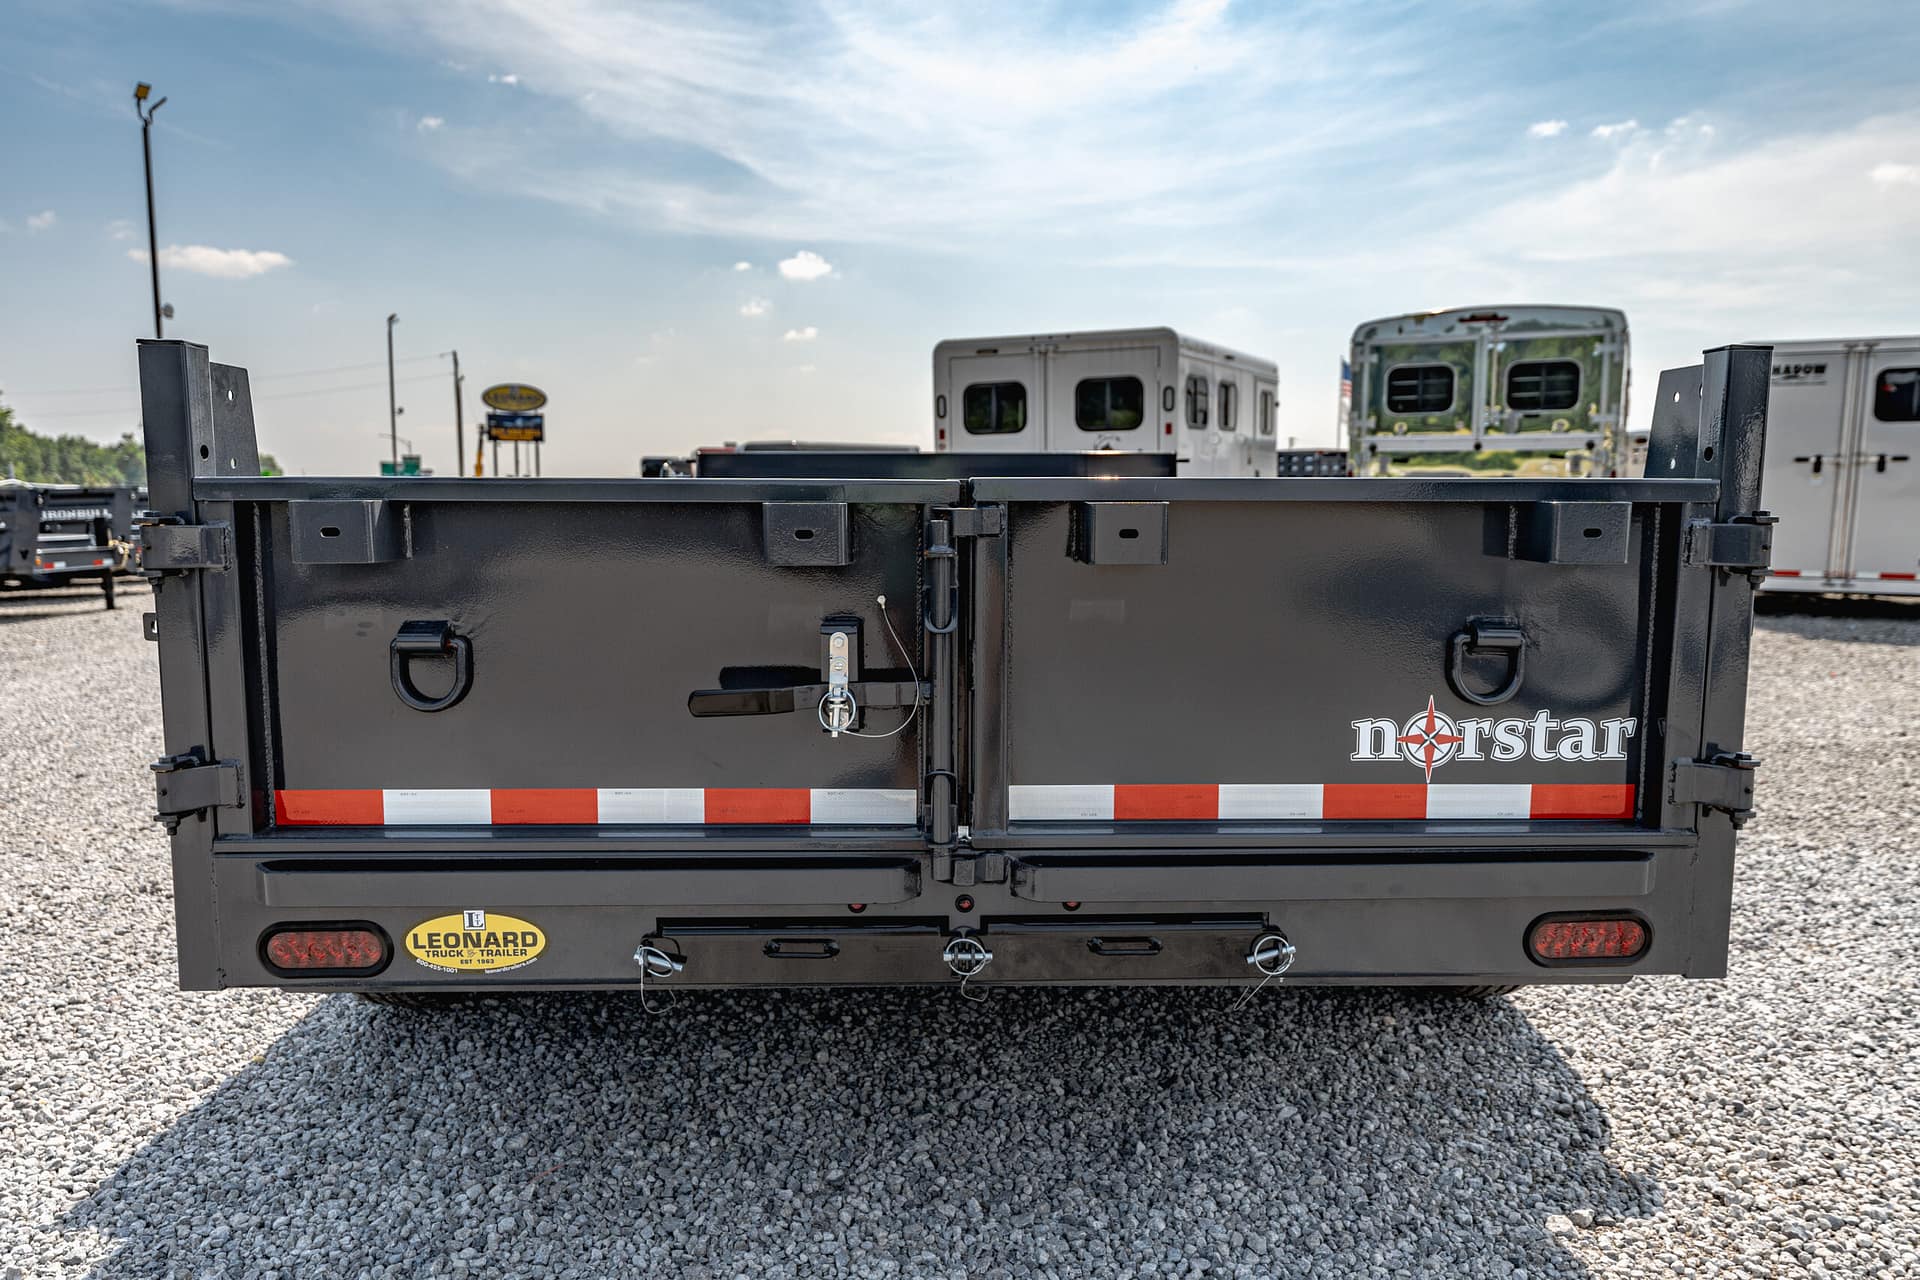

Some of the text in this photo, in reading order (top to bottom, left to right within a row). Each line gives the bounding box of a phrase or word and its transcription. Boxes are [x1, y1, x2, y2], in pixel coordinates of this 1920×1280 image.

[1772, 364, 1828, 375] HADOW
[41, 508, 113, 521] IRONBULL
[1351, 703, 1637, 766] norstar
[412, 931, 538, 949] LEONARD
[425, 949, 464, 958] TRUCK
[480, 948, 527, 957] TRAILER
